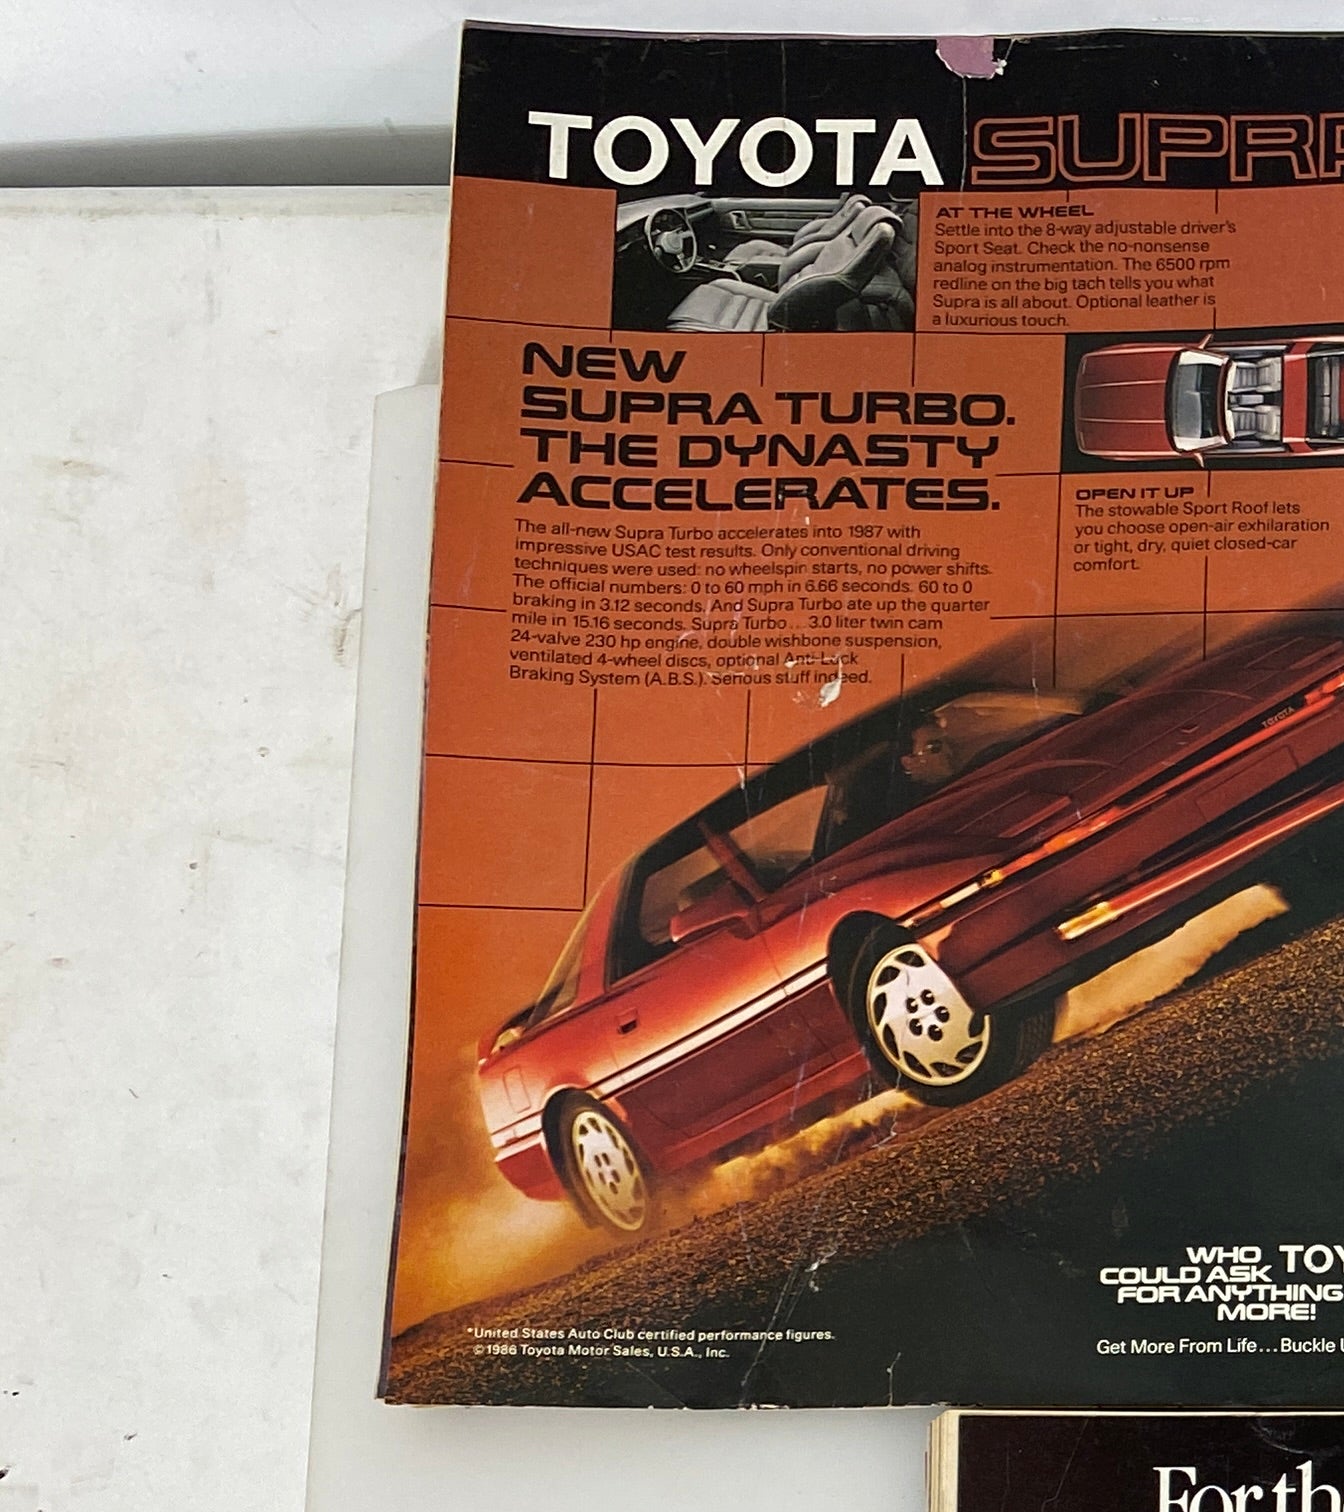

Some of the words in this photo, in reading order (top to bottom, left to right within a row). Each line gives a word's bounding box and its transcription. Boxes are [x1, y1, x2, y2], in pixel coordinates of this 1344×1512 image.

[528, 110, 944, 187] TOYOTA
[936, 207, 964, 218] AT
[969, 207, 1012, 218] THE
[1018, 206, 1093, 218] WHEEL
[521, 342, 687, 383] NEW
[521, 388, 763, 426] SUPRA
[784, 392, 1015, 426] TURBO.
[520, 430, 657, 467] THE
[679, 434, 999, 468] DYNASTY
[517, 472, 1000, 511] ACCELERATES.
[1076, 488, 1135, 500] OPEN
[1141, 488, 1160, 498] IT
[1165, 487, 1194, 498] UP
[1186, 1247, 1261, 1263] WHO
[1100, 1267, 1201, 1284] COULD
[1206, 1265, 1272, 1283] ASK
[1118, 1286, 1180, 1303] FOR
[1185, 1284, 1343, 1303] ANYTHING
[1218, 1303, 1316, 1320] MORE!
[1097, 1340, 1126, 1354] Get
[1131, 1340, 1175, 1353] More
[1180, 1339, 1222, 1353] From
